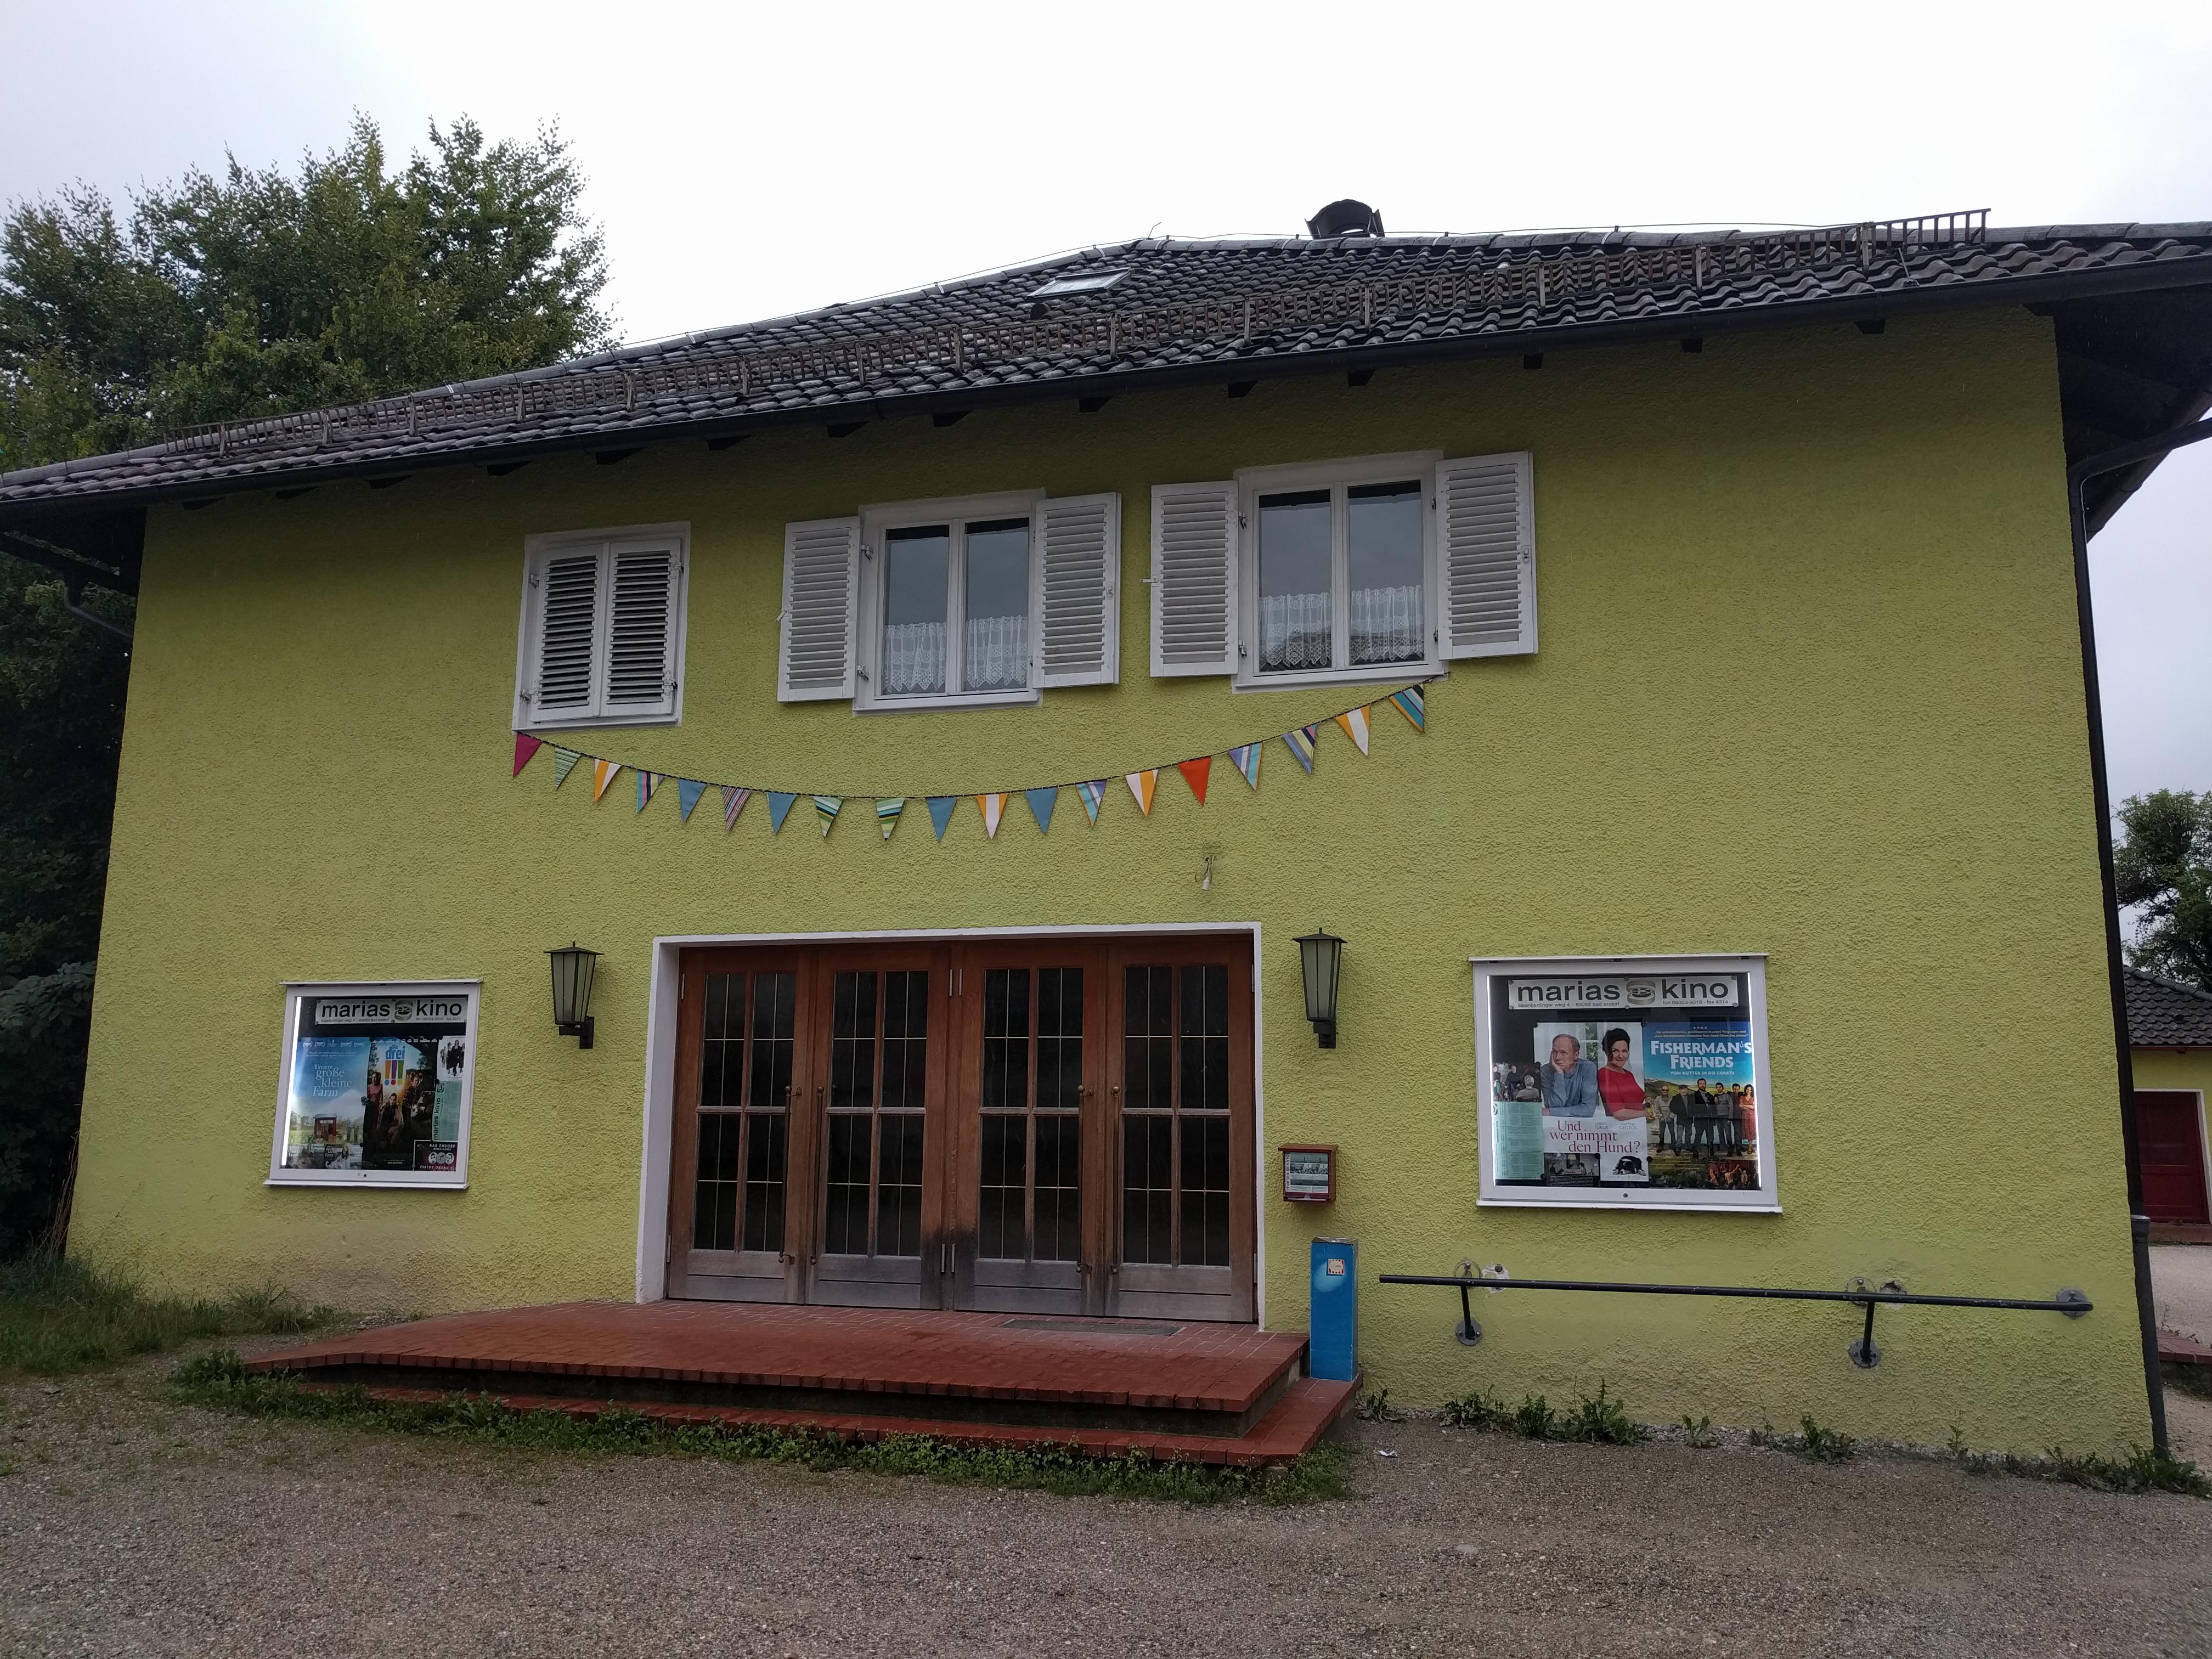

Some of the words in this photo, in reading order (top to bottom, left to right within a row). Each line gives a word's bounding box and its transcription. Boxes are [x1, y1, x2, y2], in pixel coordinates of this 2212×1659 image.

[1517, 980, 1620, 1001] marias
[1662, 979, 1728, 999] kino
[321, 1000, 390, 1018] marias
[416, 1000, 462, 1016] kino
[385, 1045, 405, 1060] drei
[1671, 1054, 1734, 1069] FRIENDS
[315, 1066, 345, 1080] große
[321, 1077, 352, 1087] kleine
[313, 1086, 338, 1097] Farm
[1558, 1120, 1581, 1131] Und
[1550, 1132, 1573, 1141] wer
[1576, 1130, 1618, 1141] nimmt
[1568, 1141, 1592, 1152] den
[1596, 1141, 1640, 1153] Hund?
